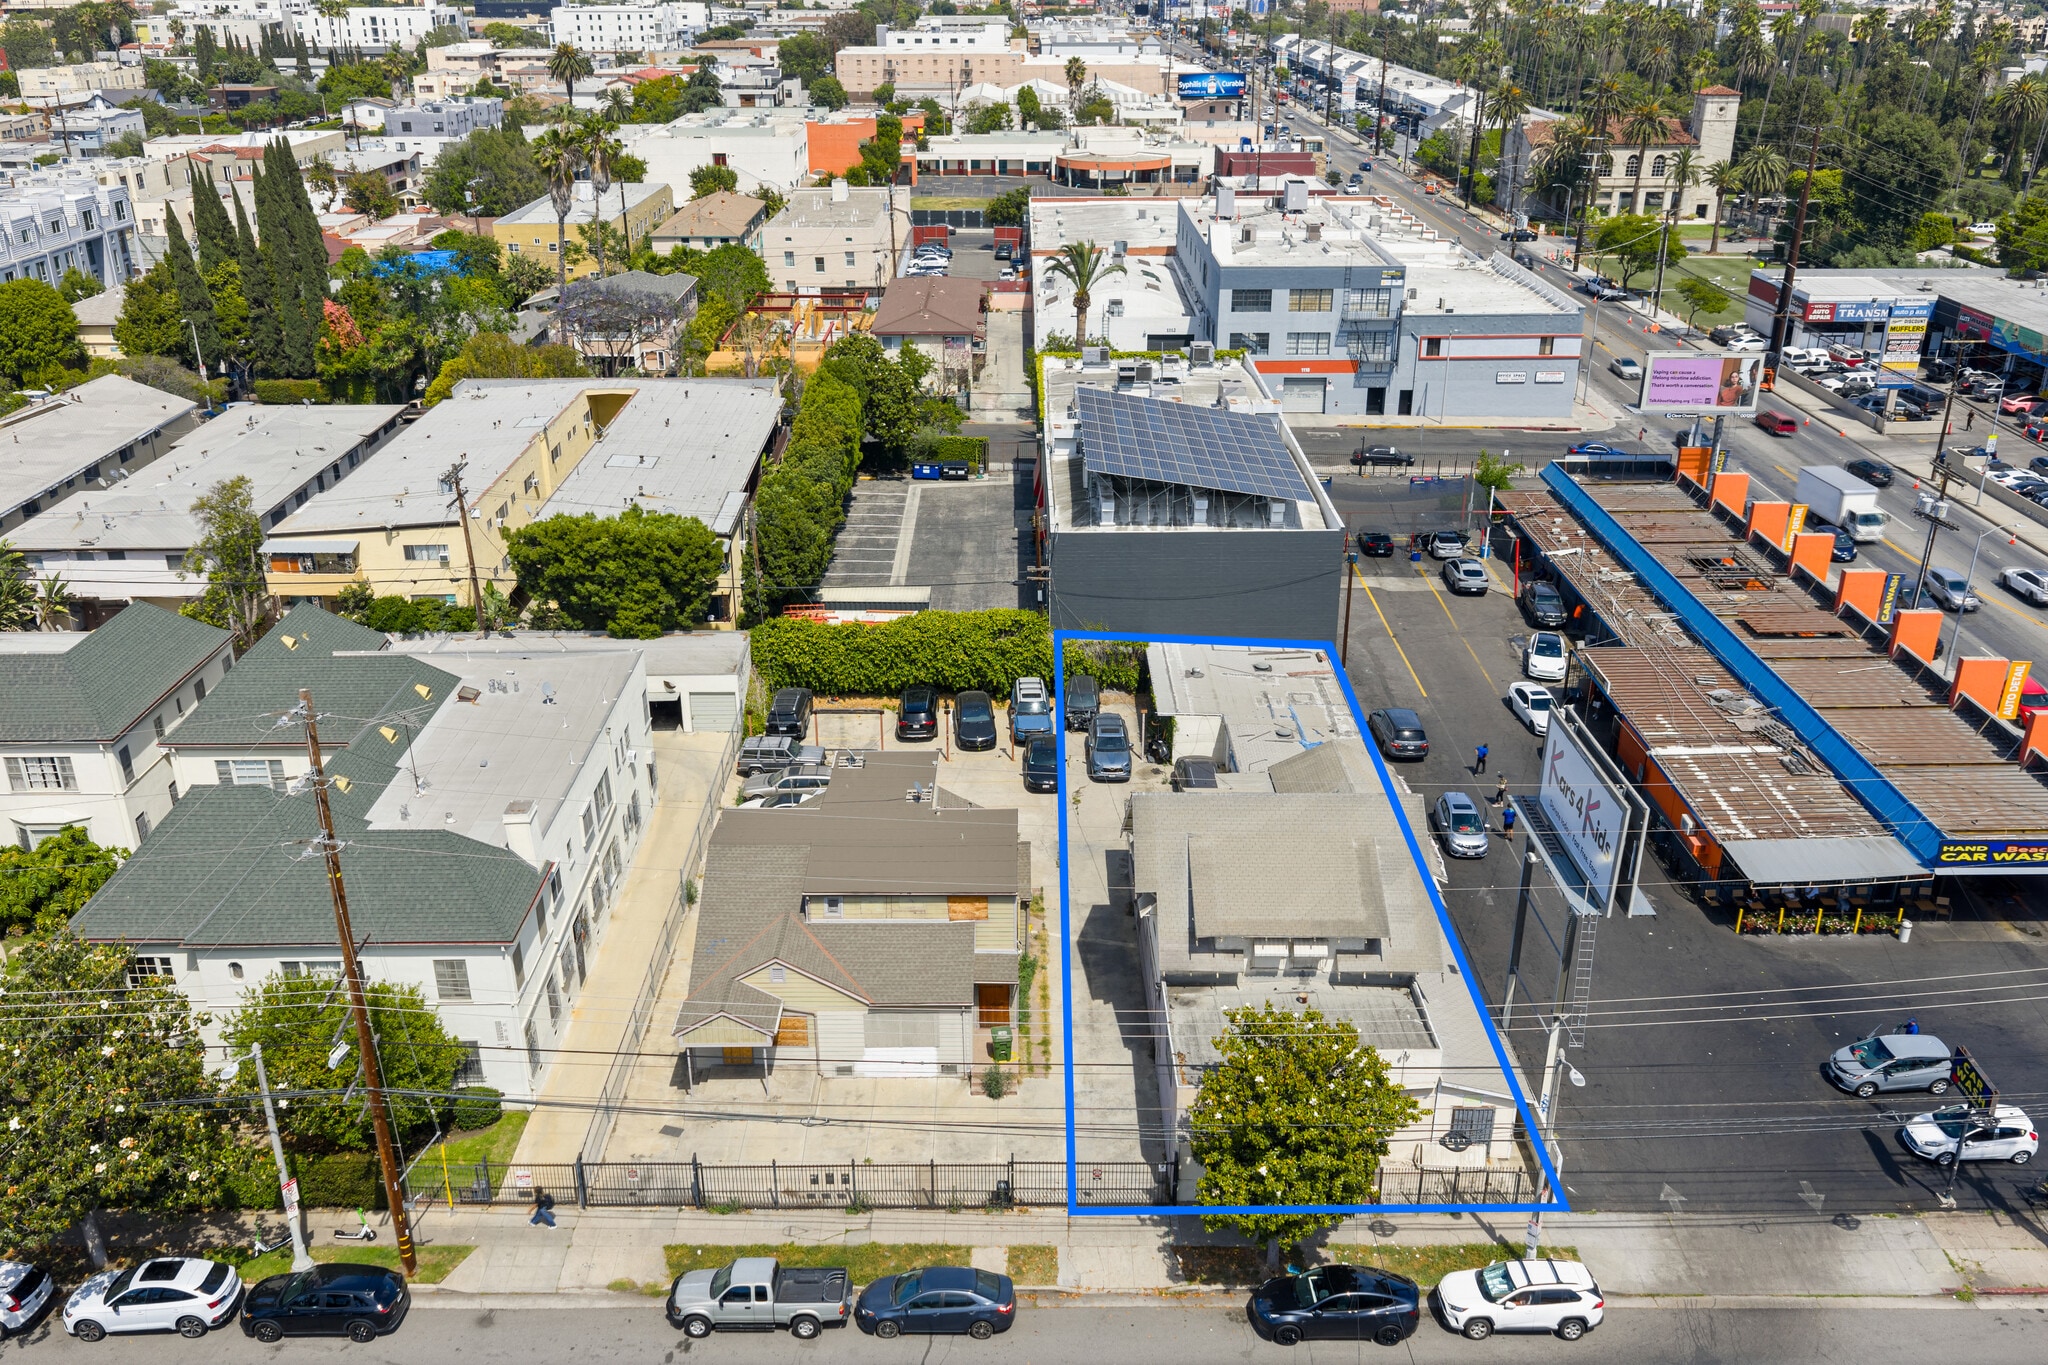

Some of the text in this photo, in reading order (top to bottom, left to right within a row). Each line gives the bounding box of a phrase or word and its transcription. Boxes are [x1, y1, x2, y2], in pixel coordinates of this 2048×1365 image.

[1178, 81, 1201, 89] Syphilis
[1838, 309, 1888, 318] TRANSM
[1971, 317, 1993, 330] AUDIO
[1791, 507, 1805, 530] DETAIL
[1881, 575, 1901, 622] CAR WASH
[2002, 664, 2027, 716] AUTO DETAIL
[1548, 739, 1611, 860] Kars 4 Kids
[1940, 852, 1988, 861] CAR
[1956, 1065, 1986, 1108] WASH
[1963, 1062, 1984, 1092] CAR
